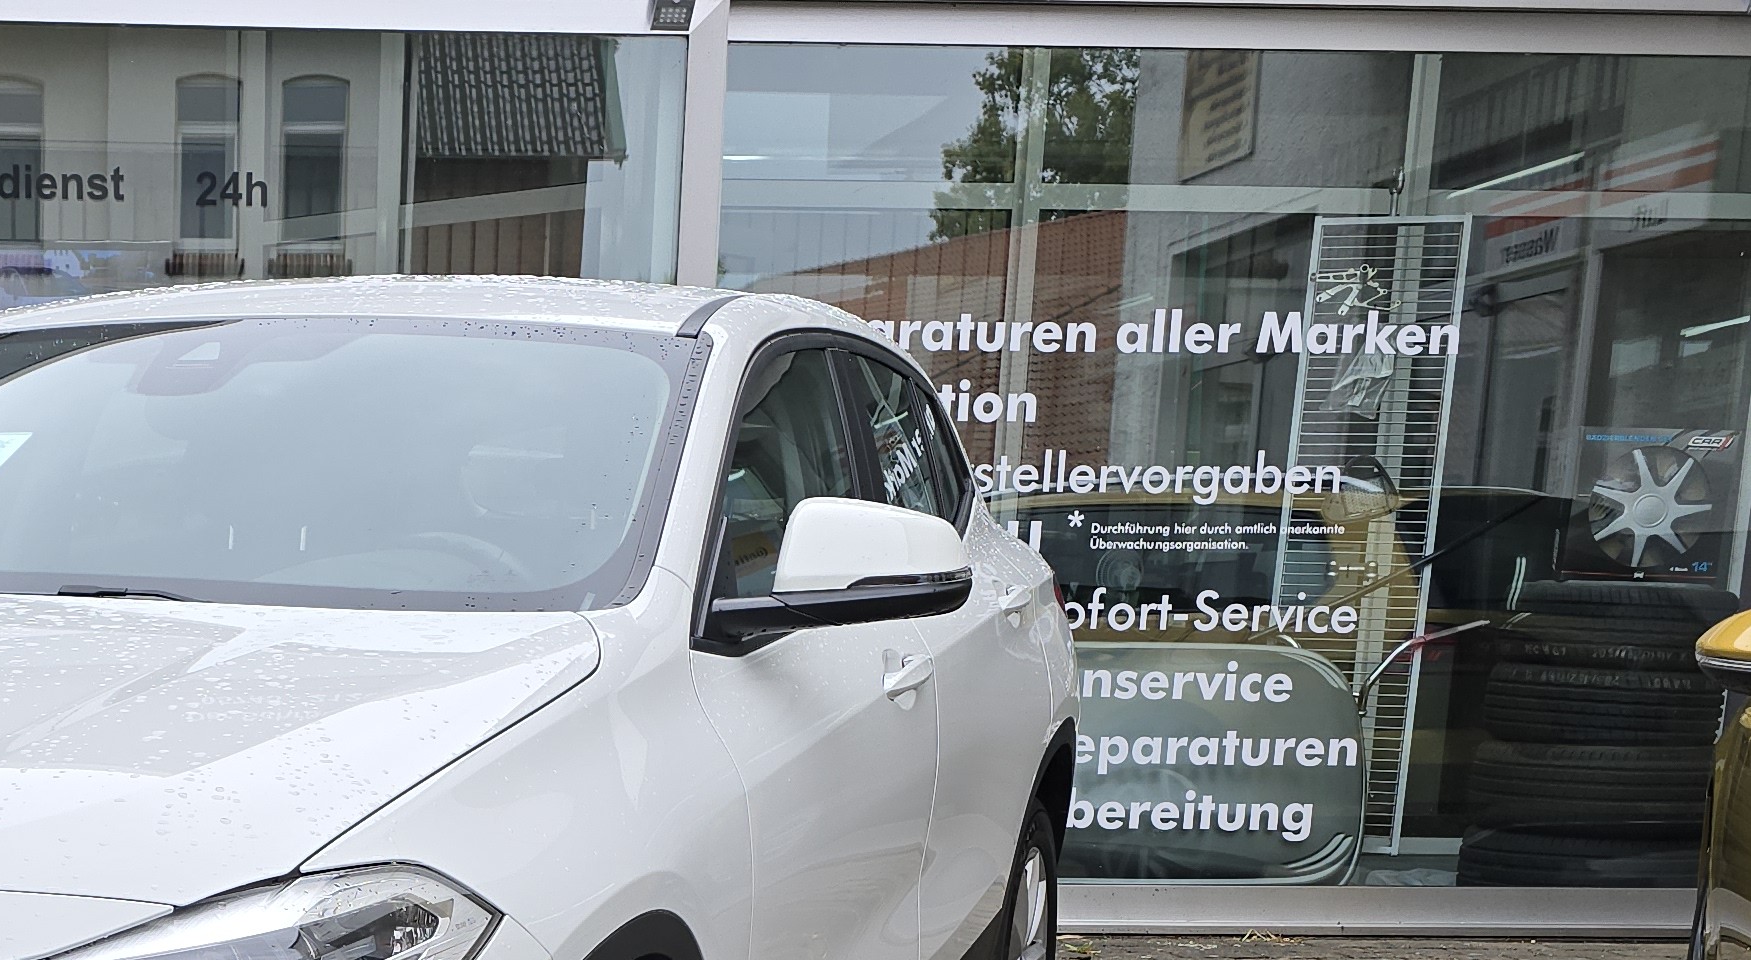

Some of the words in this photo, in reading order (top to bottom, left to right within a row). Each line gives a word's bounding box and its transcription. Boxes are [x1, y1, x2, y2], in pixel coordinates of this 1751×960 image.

[195, 171, 268, 207] 24h
[1116, 308, 1241, 355] aller
[1255, 310, 1460, 356] Marken
[1090, 535, 1249, 552] Überwachungsorganisation.
[1091, 522, 1170, 536] Durchführung
[1174, 522, 1198, 535] hier
[1200, 522, 1232, 535] durch
[1235, 522, 1277, 535] amtlich
[1280, 523, 1346, 535] anerkannte
[1082, 660, 1293, 703] nservice
[1066, 787, 1314, 842] bereitung
